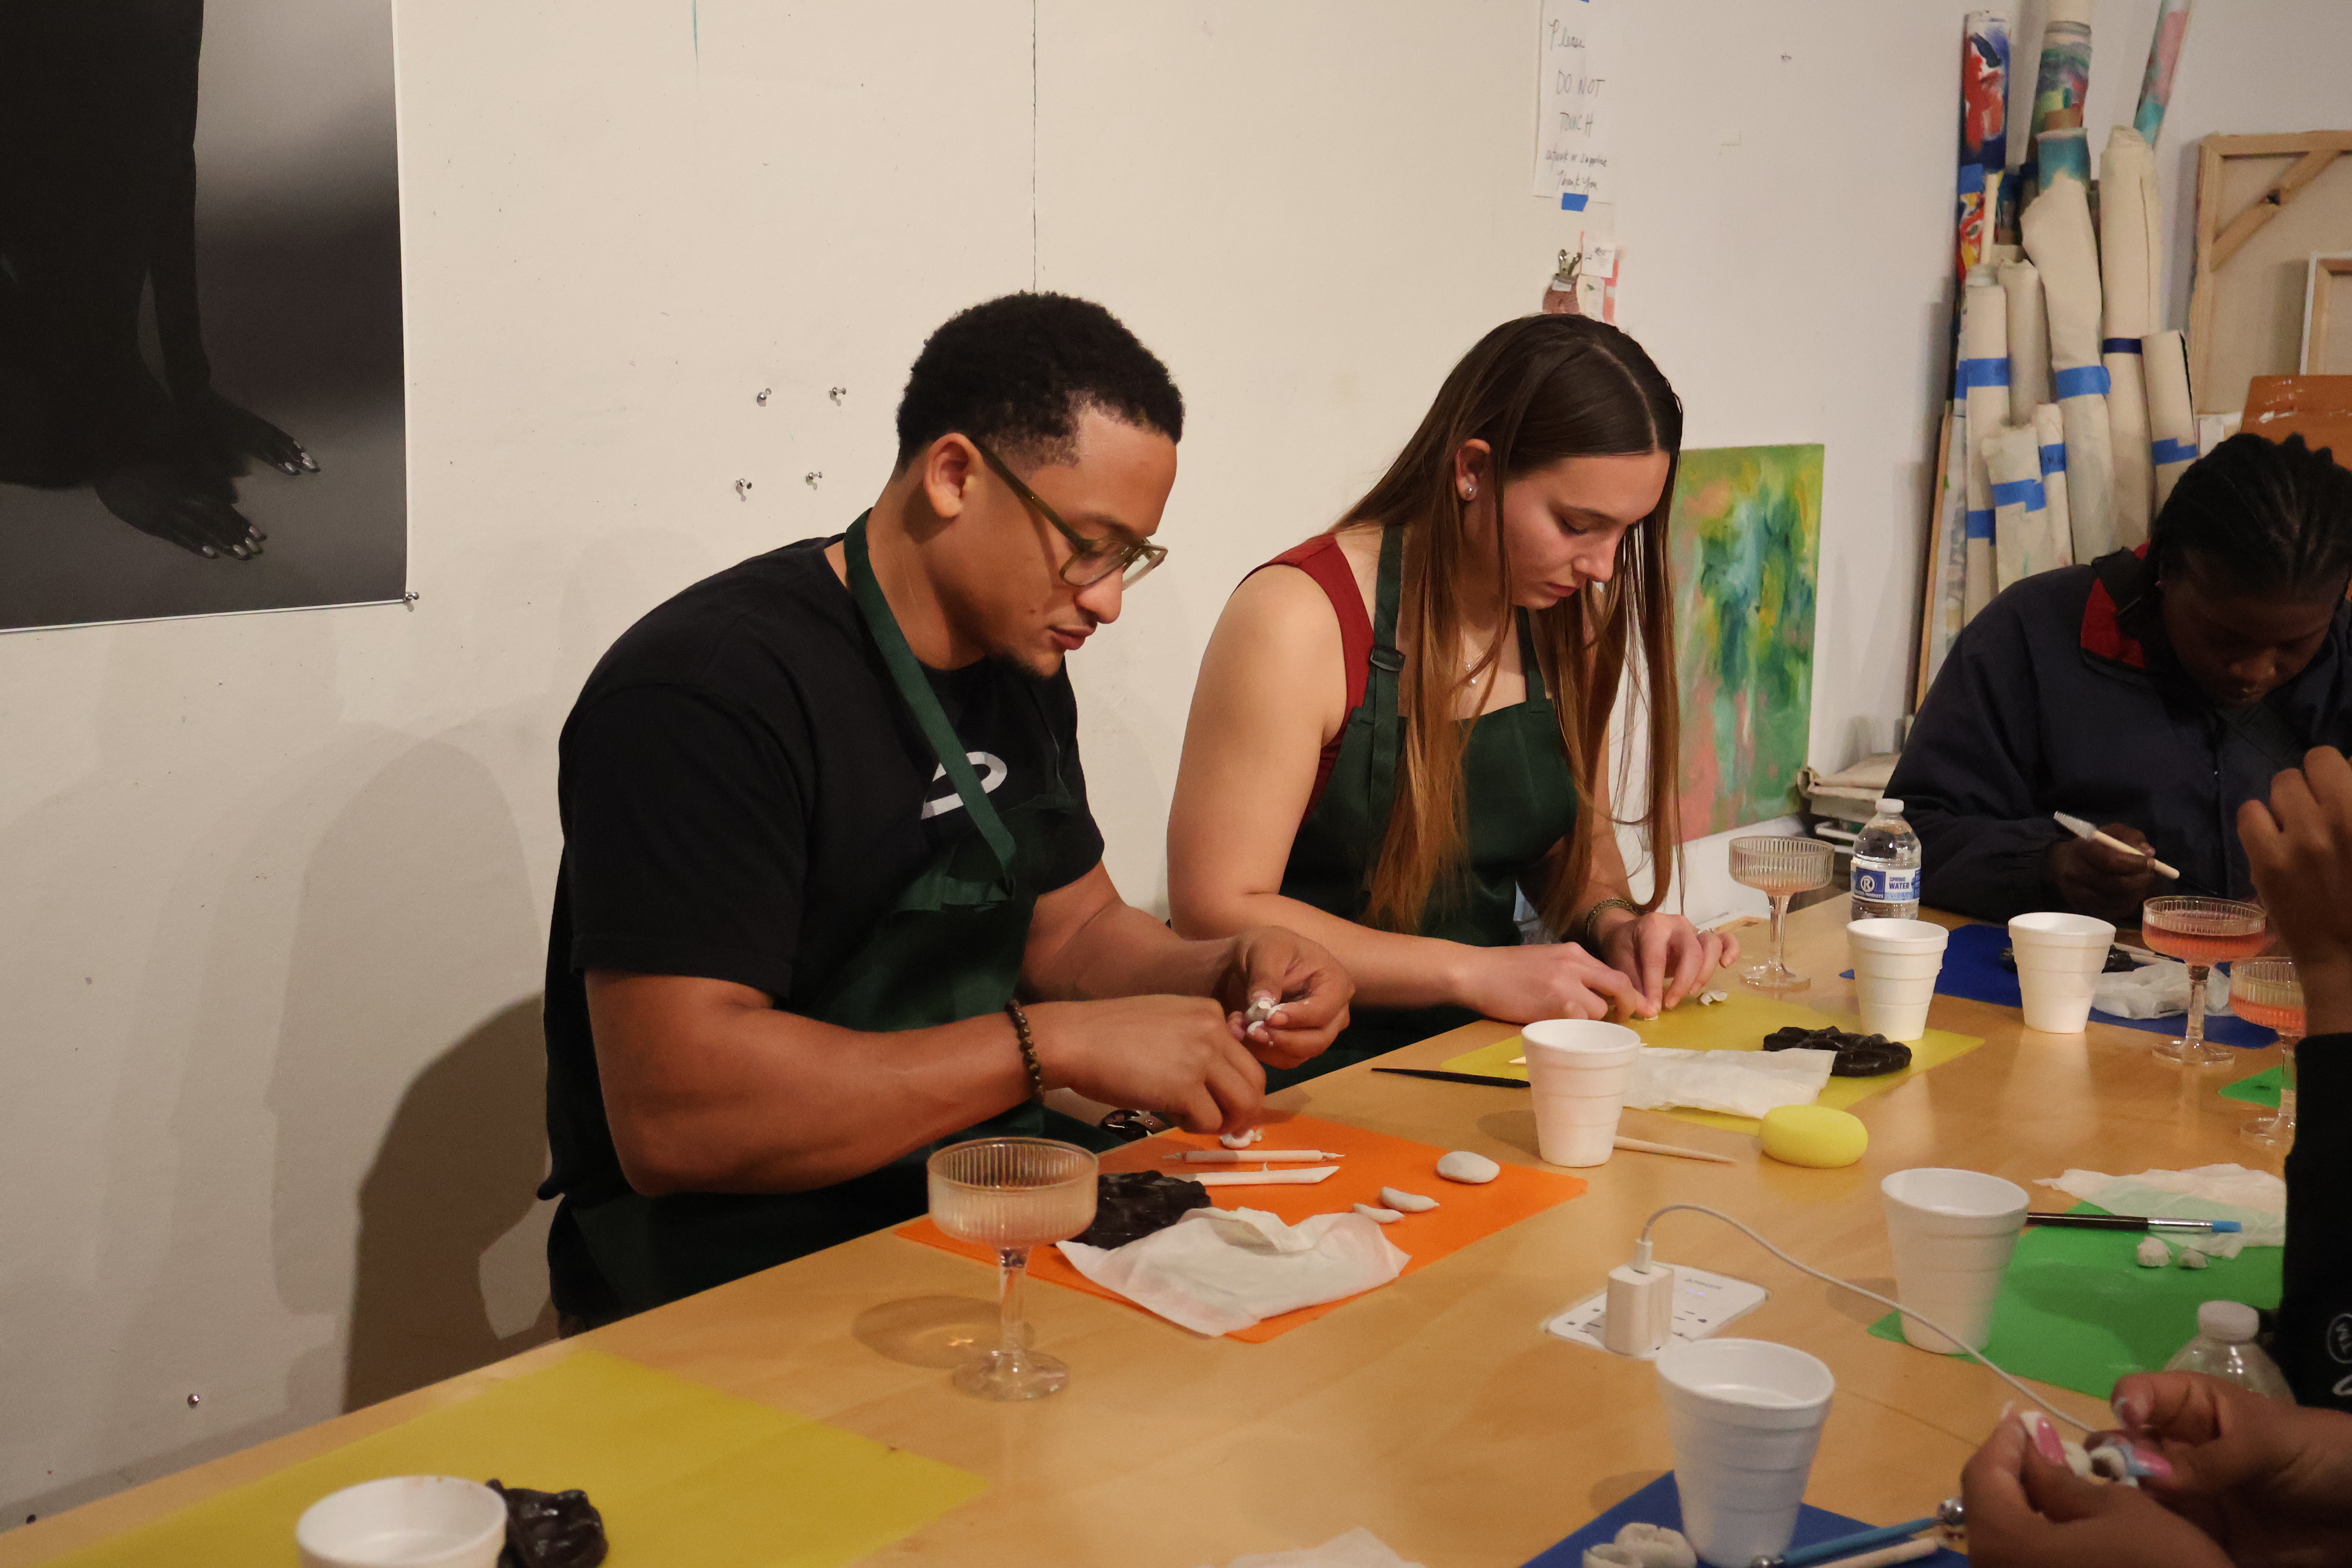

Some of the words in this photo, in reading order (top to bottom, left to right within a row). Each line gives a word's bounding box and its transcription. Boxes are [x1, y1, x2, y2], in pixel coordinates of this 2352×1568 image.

[1556, 68, 1572, 95] DO
[1579, 77, 1606, 98] NOT
[1559, 111, 1594, 138] TOUCH
